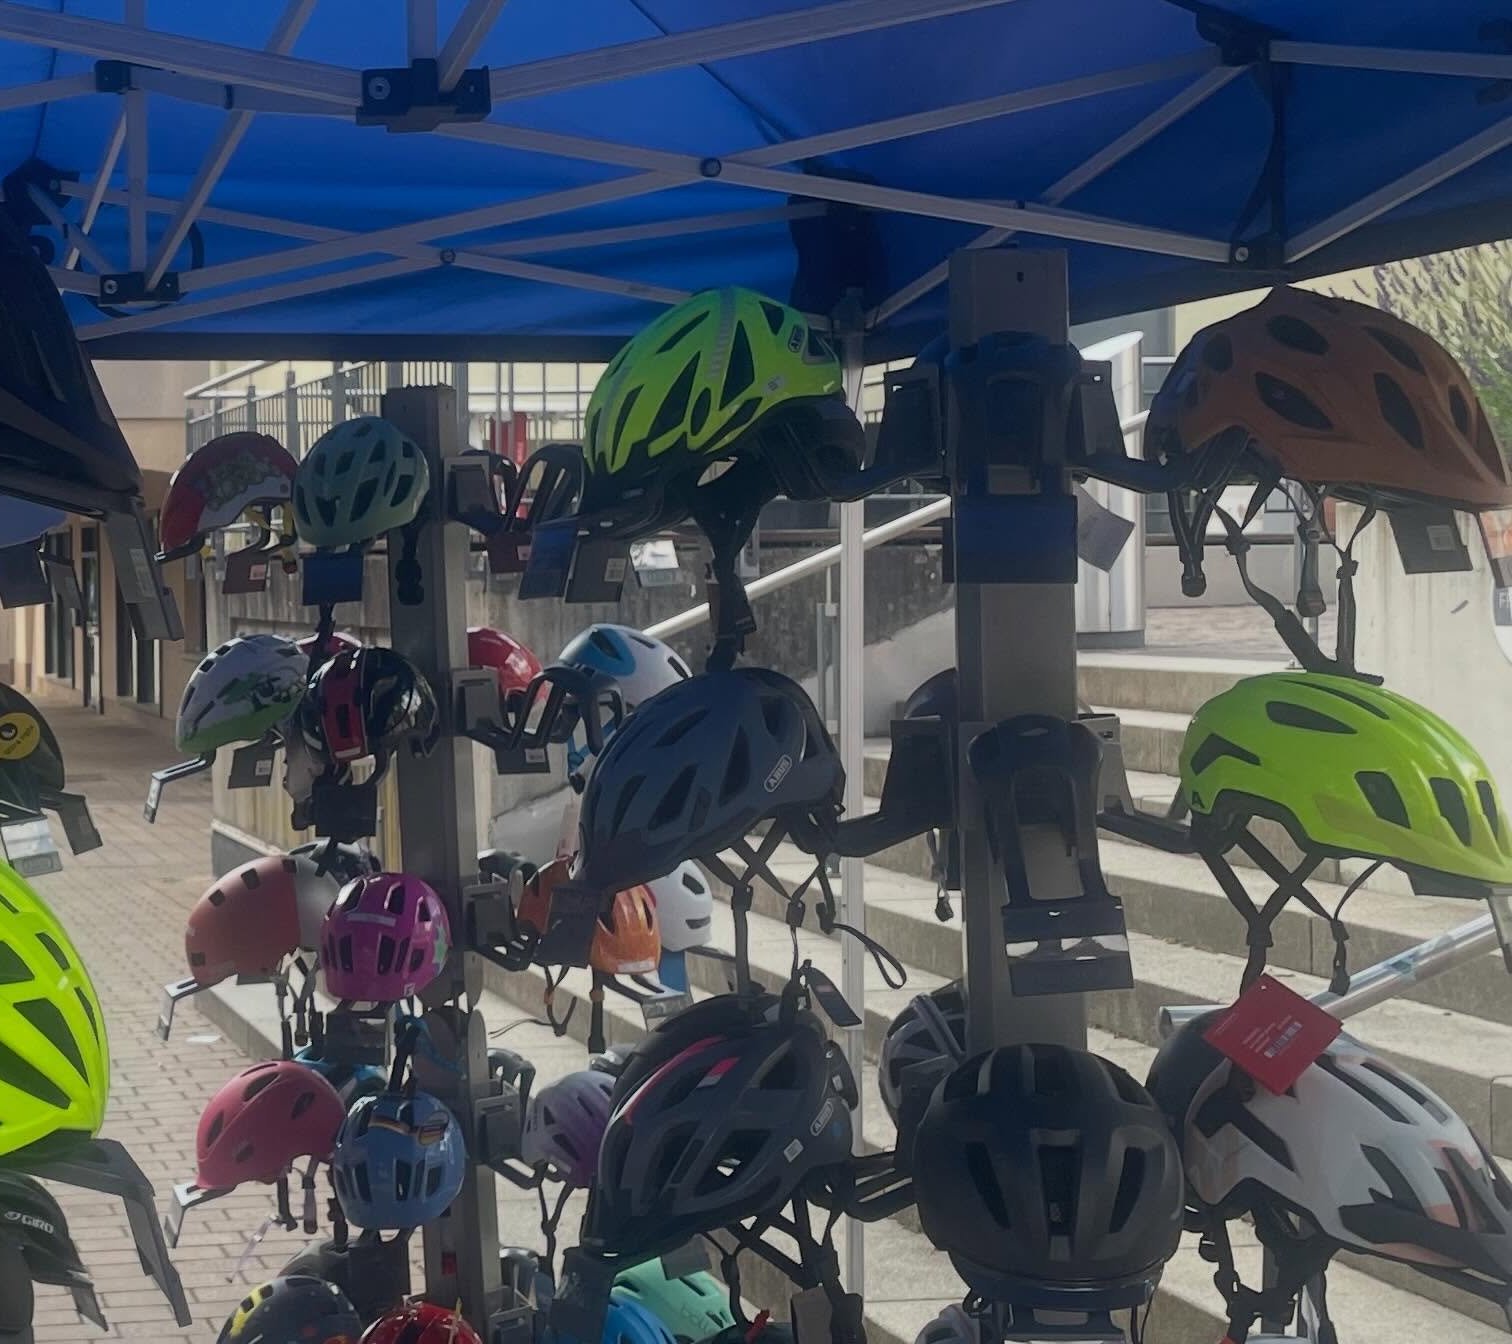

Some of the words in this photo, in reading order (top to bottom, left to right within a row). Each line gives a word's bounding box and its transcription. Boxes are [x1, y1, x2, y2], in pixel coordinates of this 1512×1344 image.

[767, 758, 790, 788] ABUS
[813, 1102, 831, 1132] ABUS
[21, 1214, 55, 1234] GIRO
